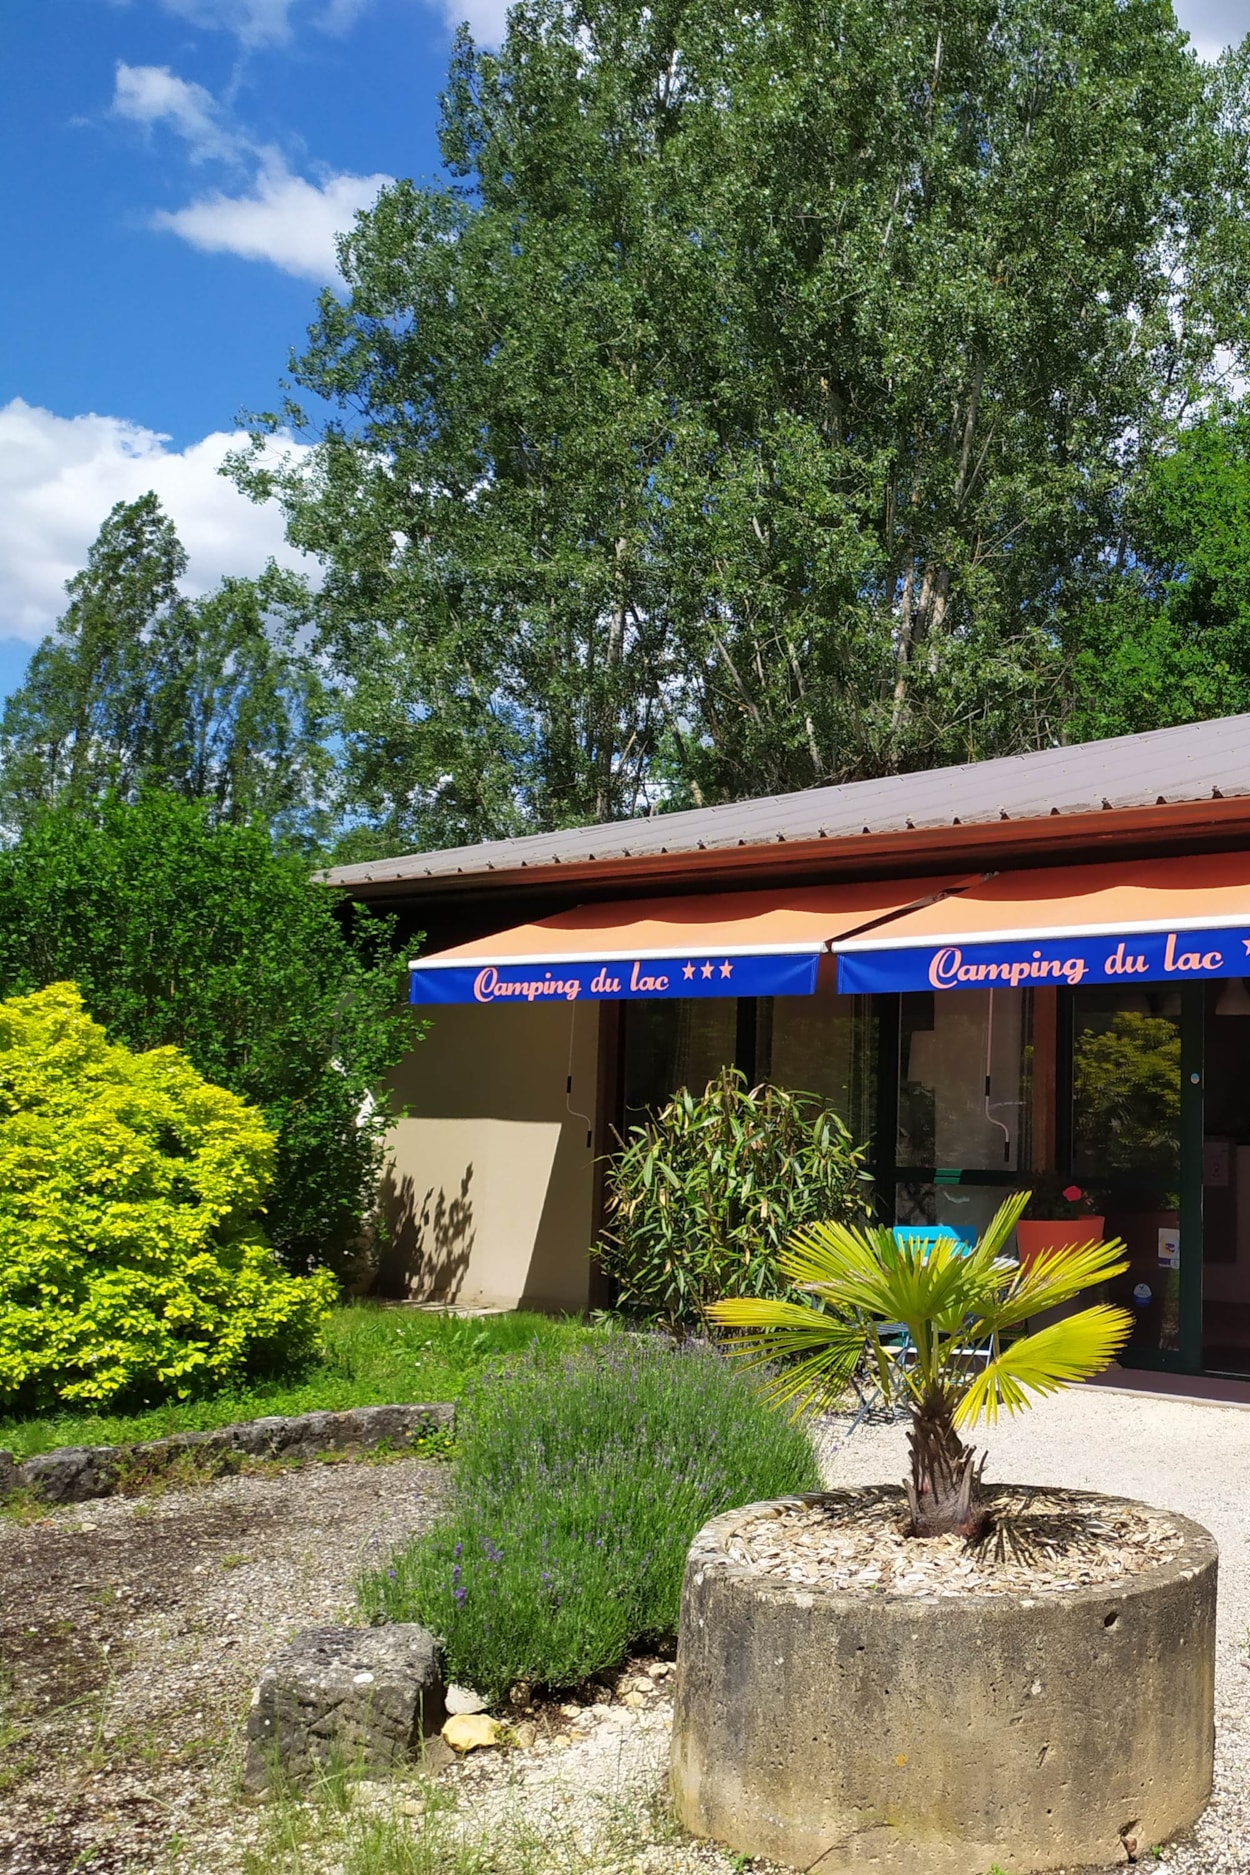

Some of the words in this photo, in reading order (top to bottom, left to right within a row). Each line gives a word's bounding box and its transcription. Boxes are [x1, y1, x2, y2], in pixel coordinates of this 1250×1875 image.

[473, 967, 581, 1002] Camping
[590, 967, 621, 993] du
[630, 961, 669, 991] lac
[928, 947, 1090, 989] Camping
[1104, 943, 1149, 974] du
[1164, 933, 1224, 971] lac
